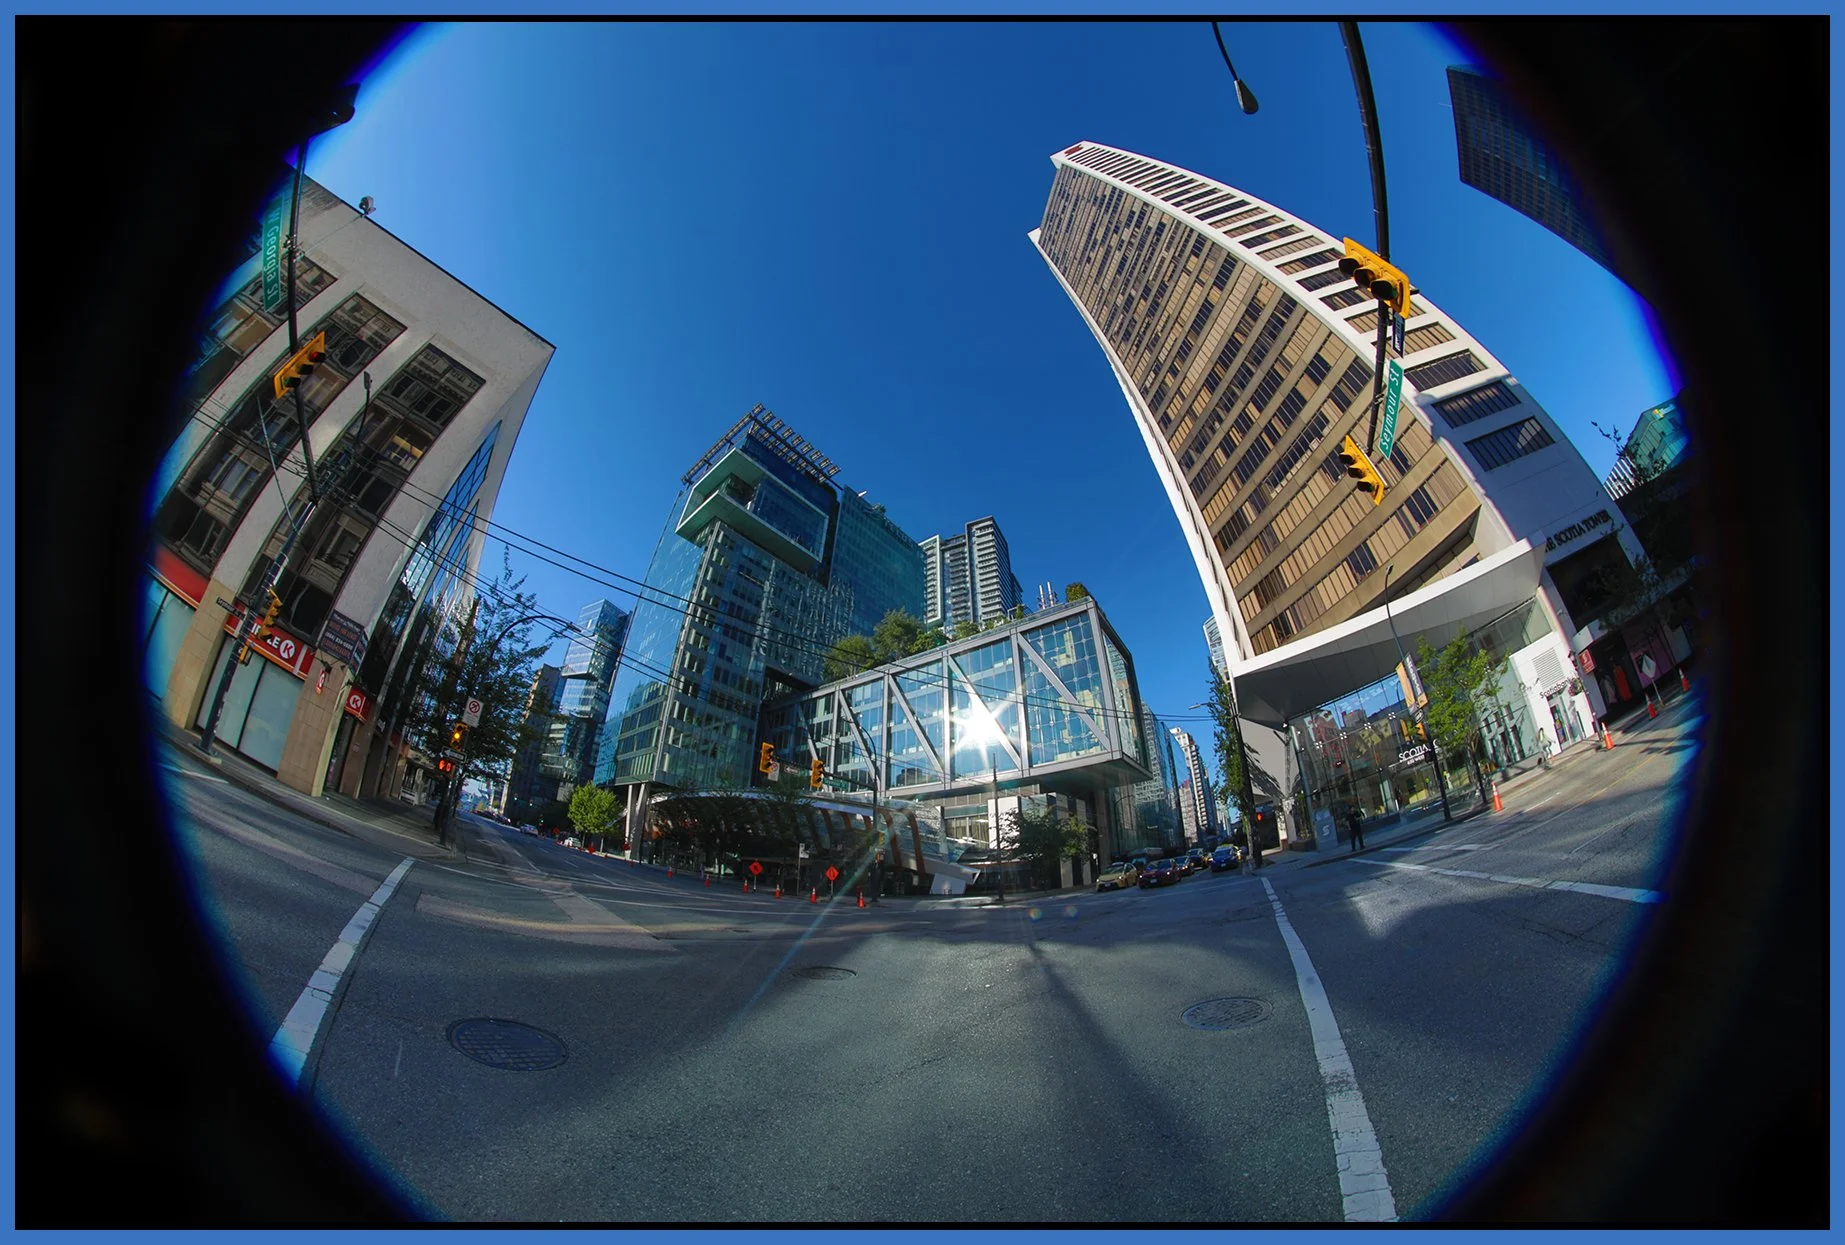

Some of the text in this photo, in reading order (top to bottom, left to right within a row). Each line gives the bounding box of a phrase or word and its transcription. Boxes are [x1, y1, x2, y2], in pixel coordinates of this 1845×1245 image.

[264, 207, 280, 300] W Georgia St
[1380, 370, 1400, 450] Seymour St
[1554, 523, 1587, 546] SCOTIA
[281, 641, 294, 659] K
[350, 695, 362, 708] K
[1398, 743, 1429, 761] SCOTIA
